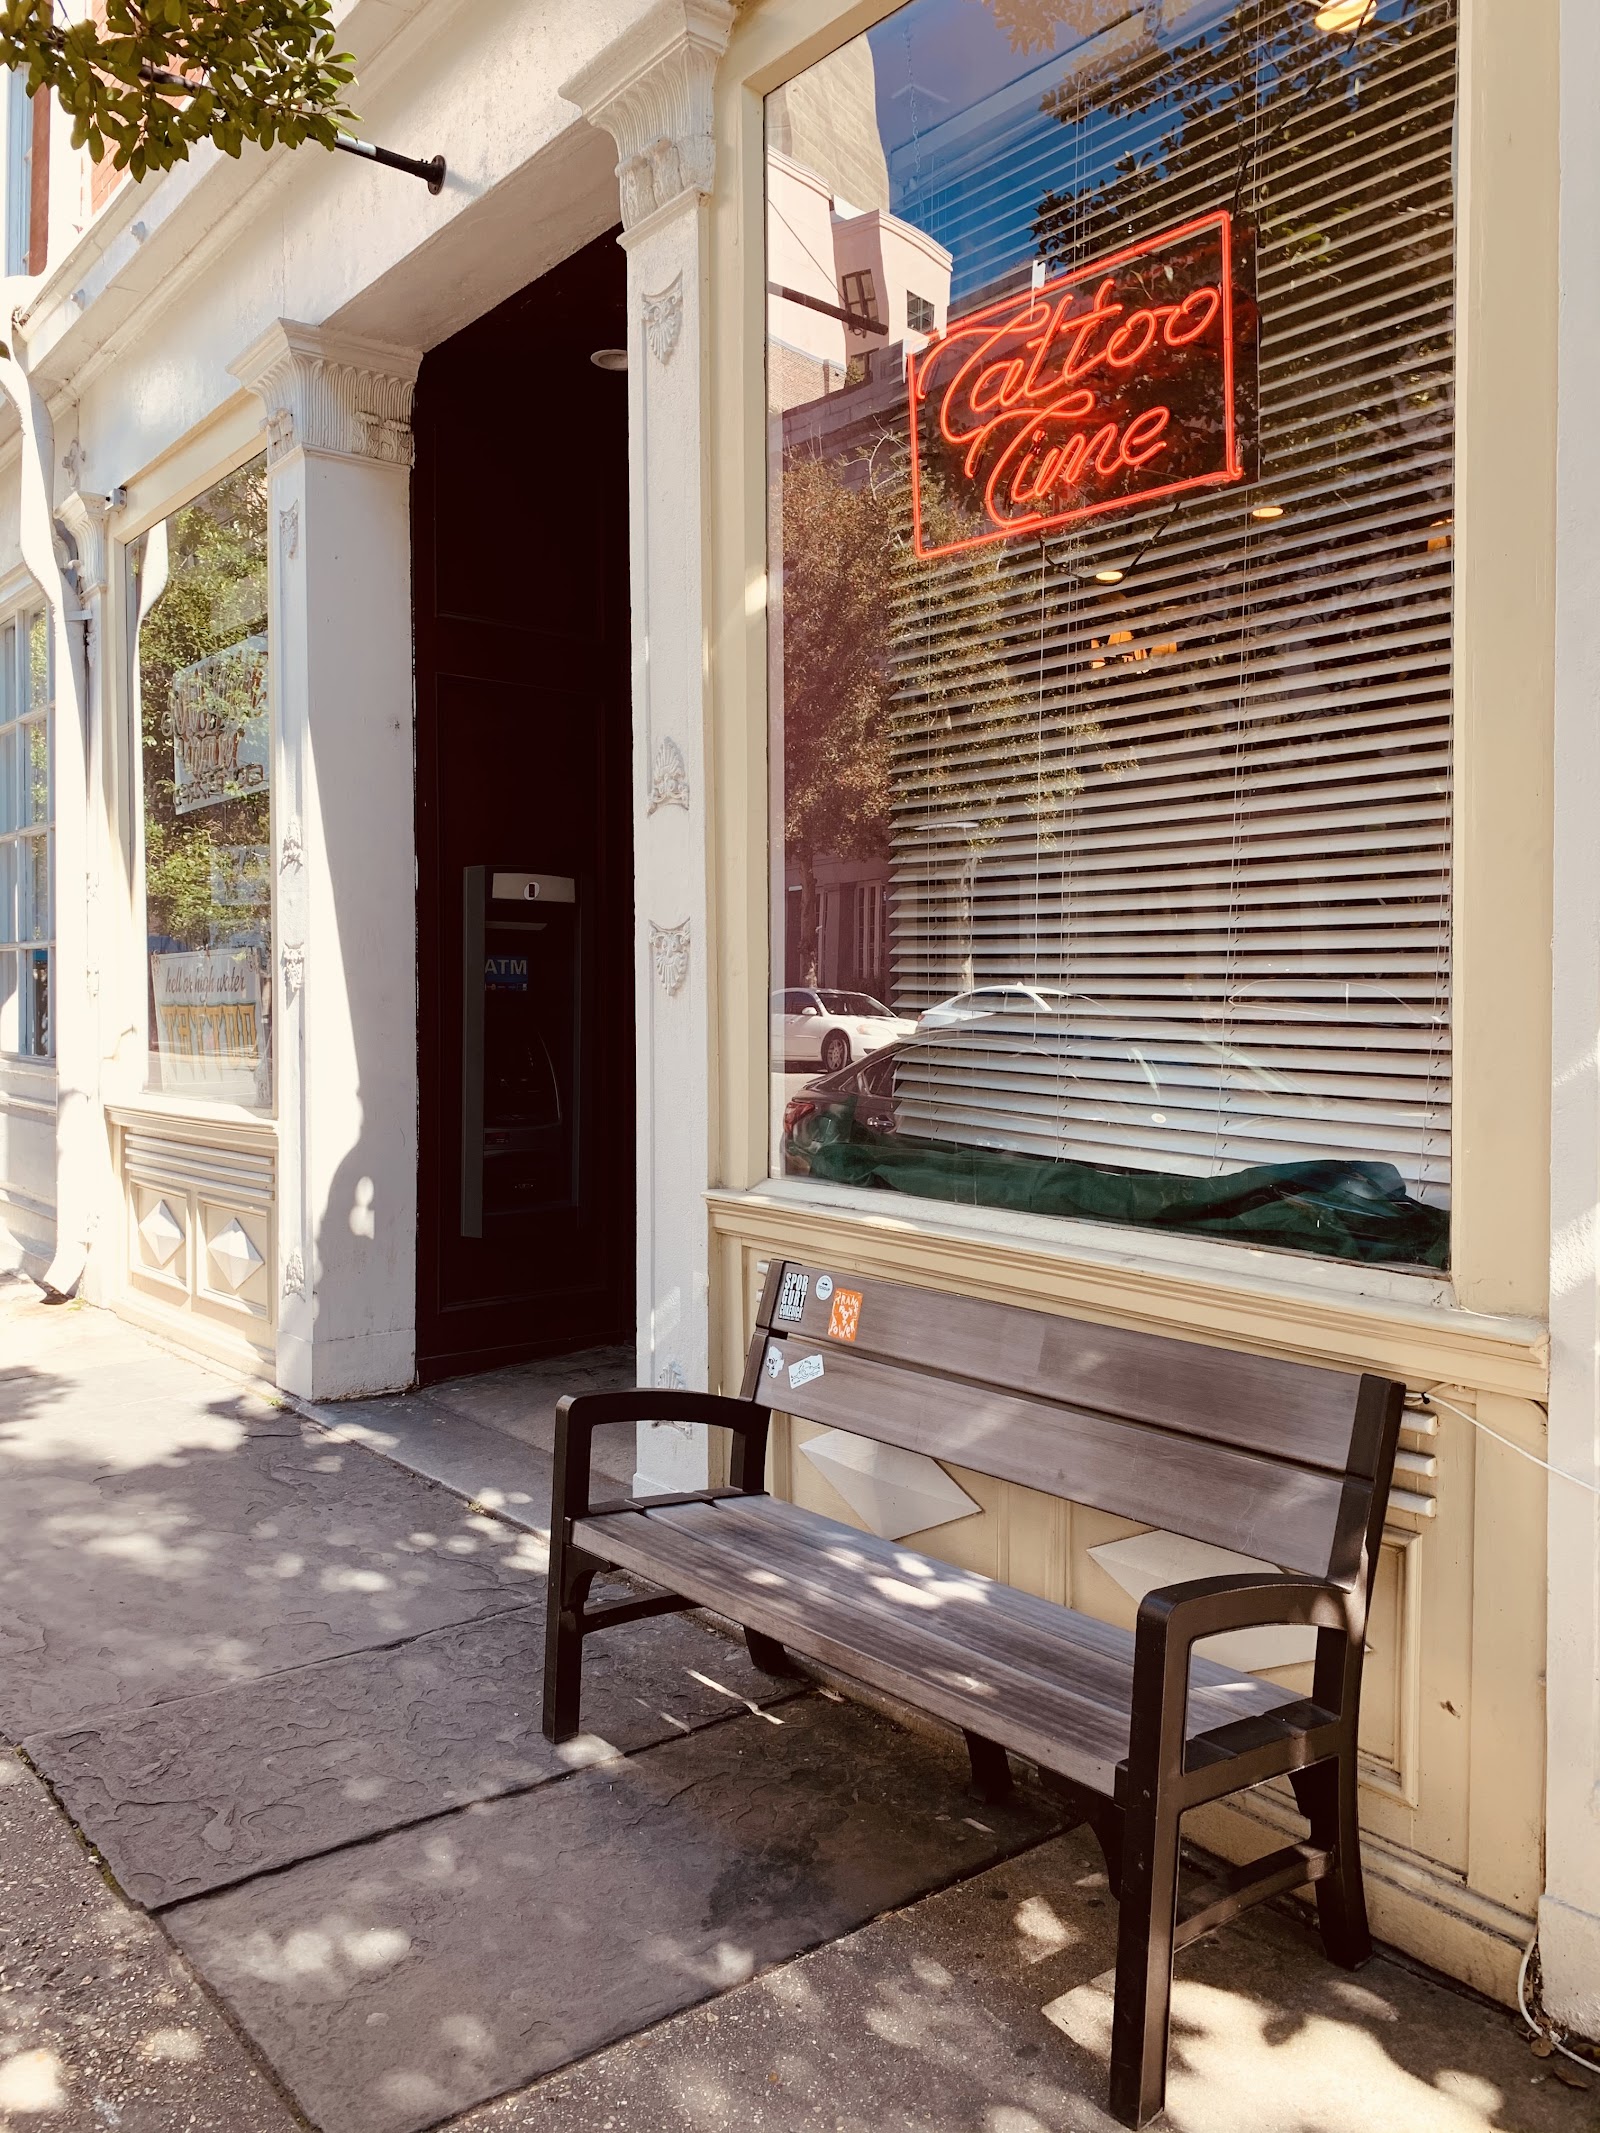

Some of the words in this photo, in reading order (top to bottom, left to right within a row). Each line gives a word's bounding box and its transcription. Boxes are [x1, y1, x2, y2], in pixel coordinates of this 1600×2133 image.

[916, 278, 1220, 444] Tattoo
[964, 389, 1171, 528] Time
[165, 967, 183, 993] hell
[184, 976, 193, 993] or
[194, 966, 214, 1002] high
[216, 967, 246, 993] water
[485, 958, 527, 975] ATM
[159, 1002, 258, 1080] TATTOO
[782, 1289, 807, 1307] GURT
[785, 1272, 809, 1292] SPOR
